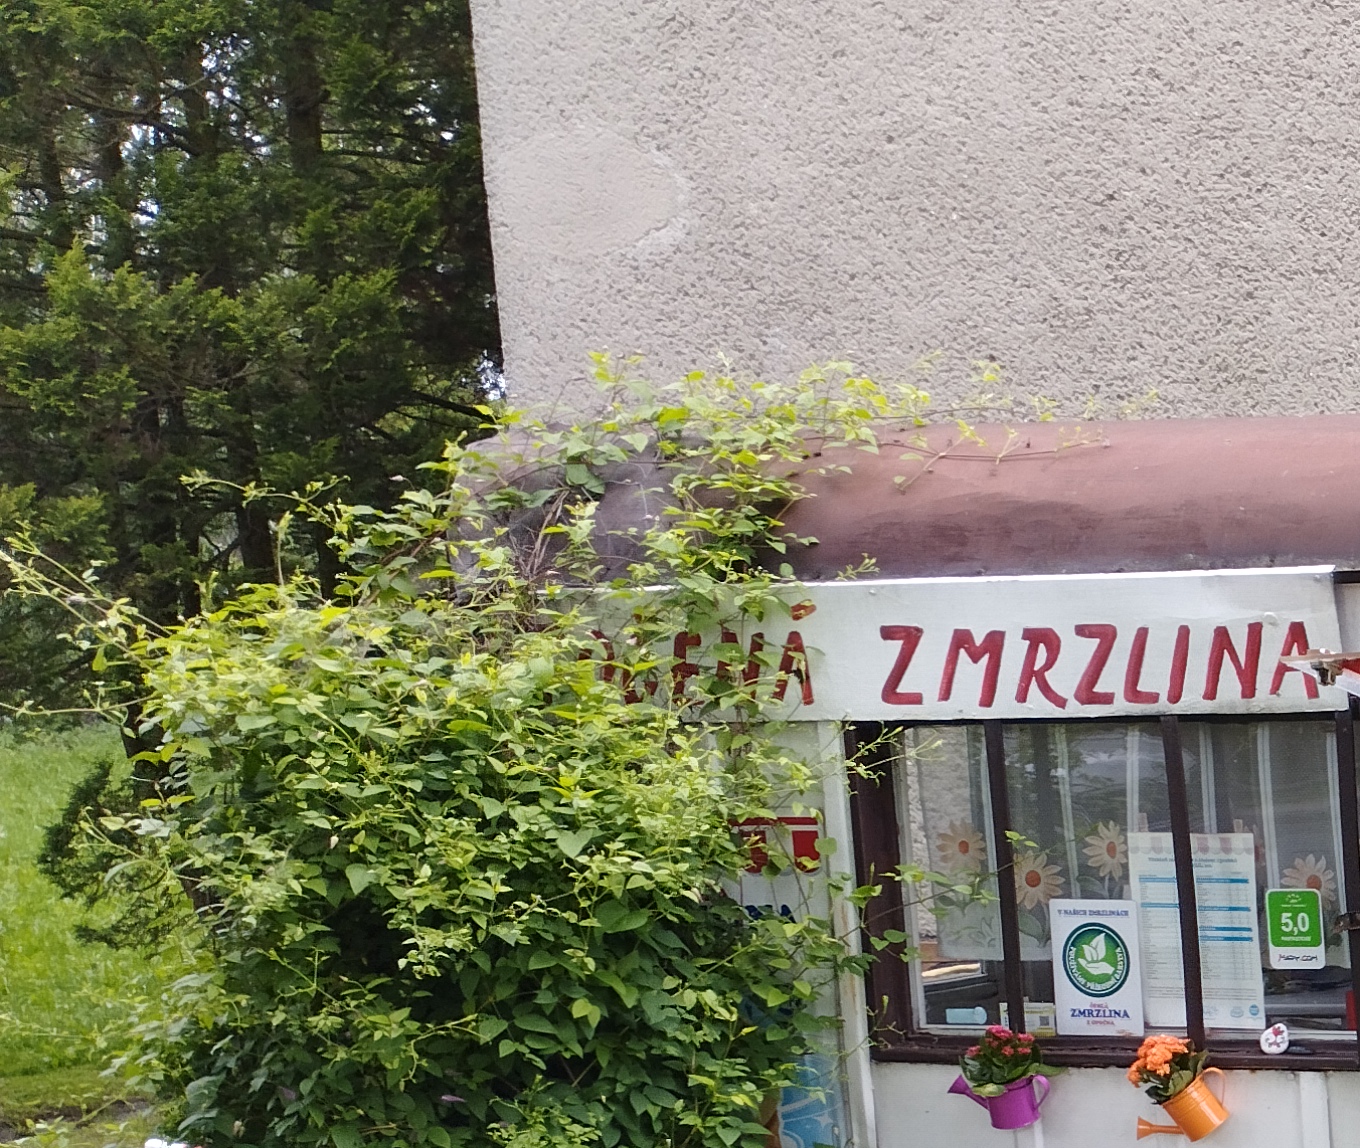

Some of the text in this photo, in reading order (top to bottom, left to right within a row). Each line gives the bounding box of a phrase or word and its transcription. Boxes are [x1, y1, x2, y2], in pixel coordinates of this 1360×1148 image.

[880, 620, 1321, 709] ZMRZLINA
[1281, 912, 1309, 936] 5,0
[1070, 1008, 1131, 1018] ZMRZLINA
